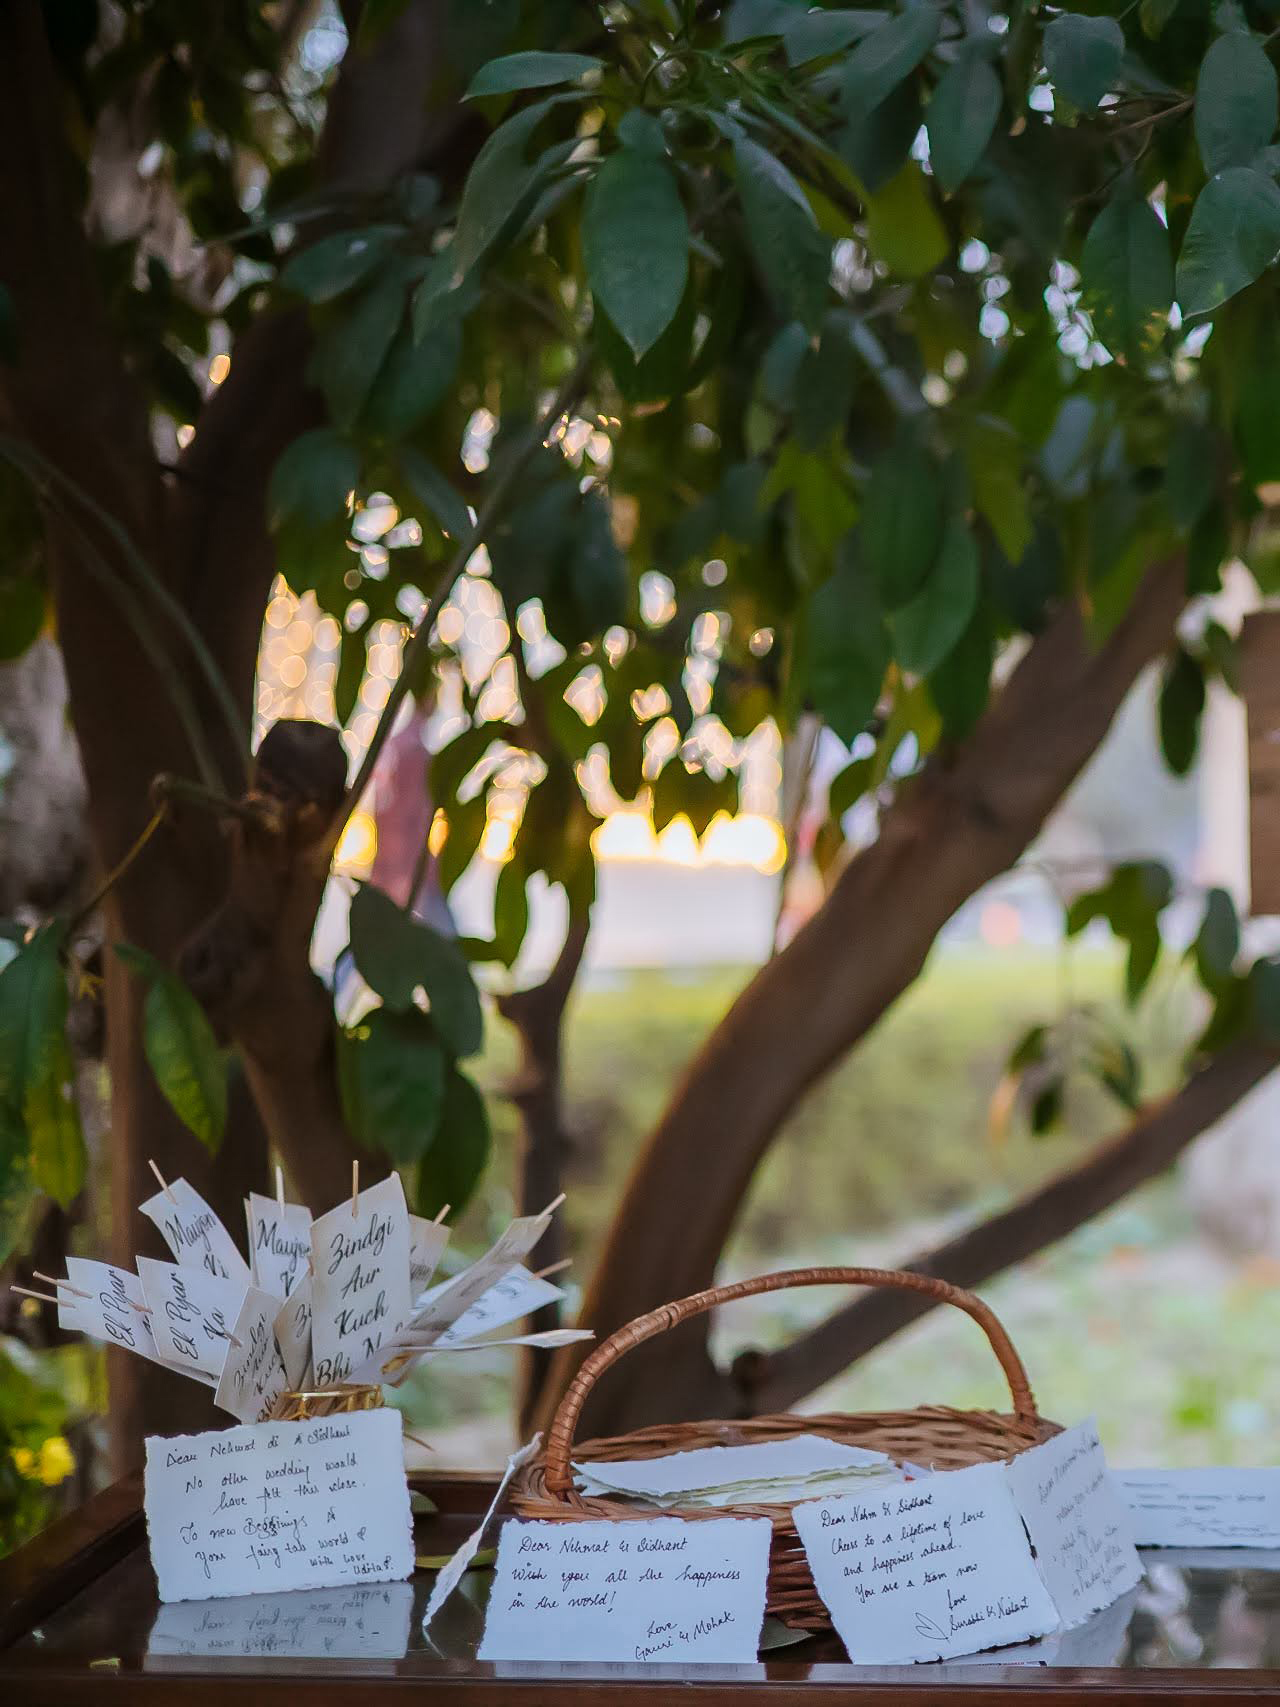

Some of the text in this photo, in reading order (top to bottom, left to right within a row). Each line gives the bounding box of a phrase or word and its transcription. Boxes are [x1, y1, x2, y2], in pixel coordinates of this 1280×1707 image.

[328, 1213, 394, 1275] Zindgi
[341, 1265, 382, 1299] Aur
[334, 1291, 389, 1339] Kuch
[166, 1449, 197, 1467] Dear
[186, 1477, 202, 1493] No
[213, 1491, 247, 1515] have
[821, 1510, 846, 1528] Dear
[864, 1534, 875, 1548] to
[943, 1515, 952, 1536] of
[180, 1522, 198, 1544] To
[210, 1527, 236, 1539] new
[518, 1536, 551, 1555] Dear
[512, 1559, 741, 1592] Wish you all the happiness
[843, 1565, 864, 1577] and
[872, 1551, 914, 1573] happiness
[906, 1580, 914, 1588] a
[956, 1562, 978, 1577] now
[509, 1591, 617, 1614] in the world!
[693, 1610, 735, 1640] Mohak
